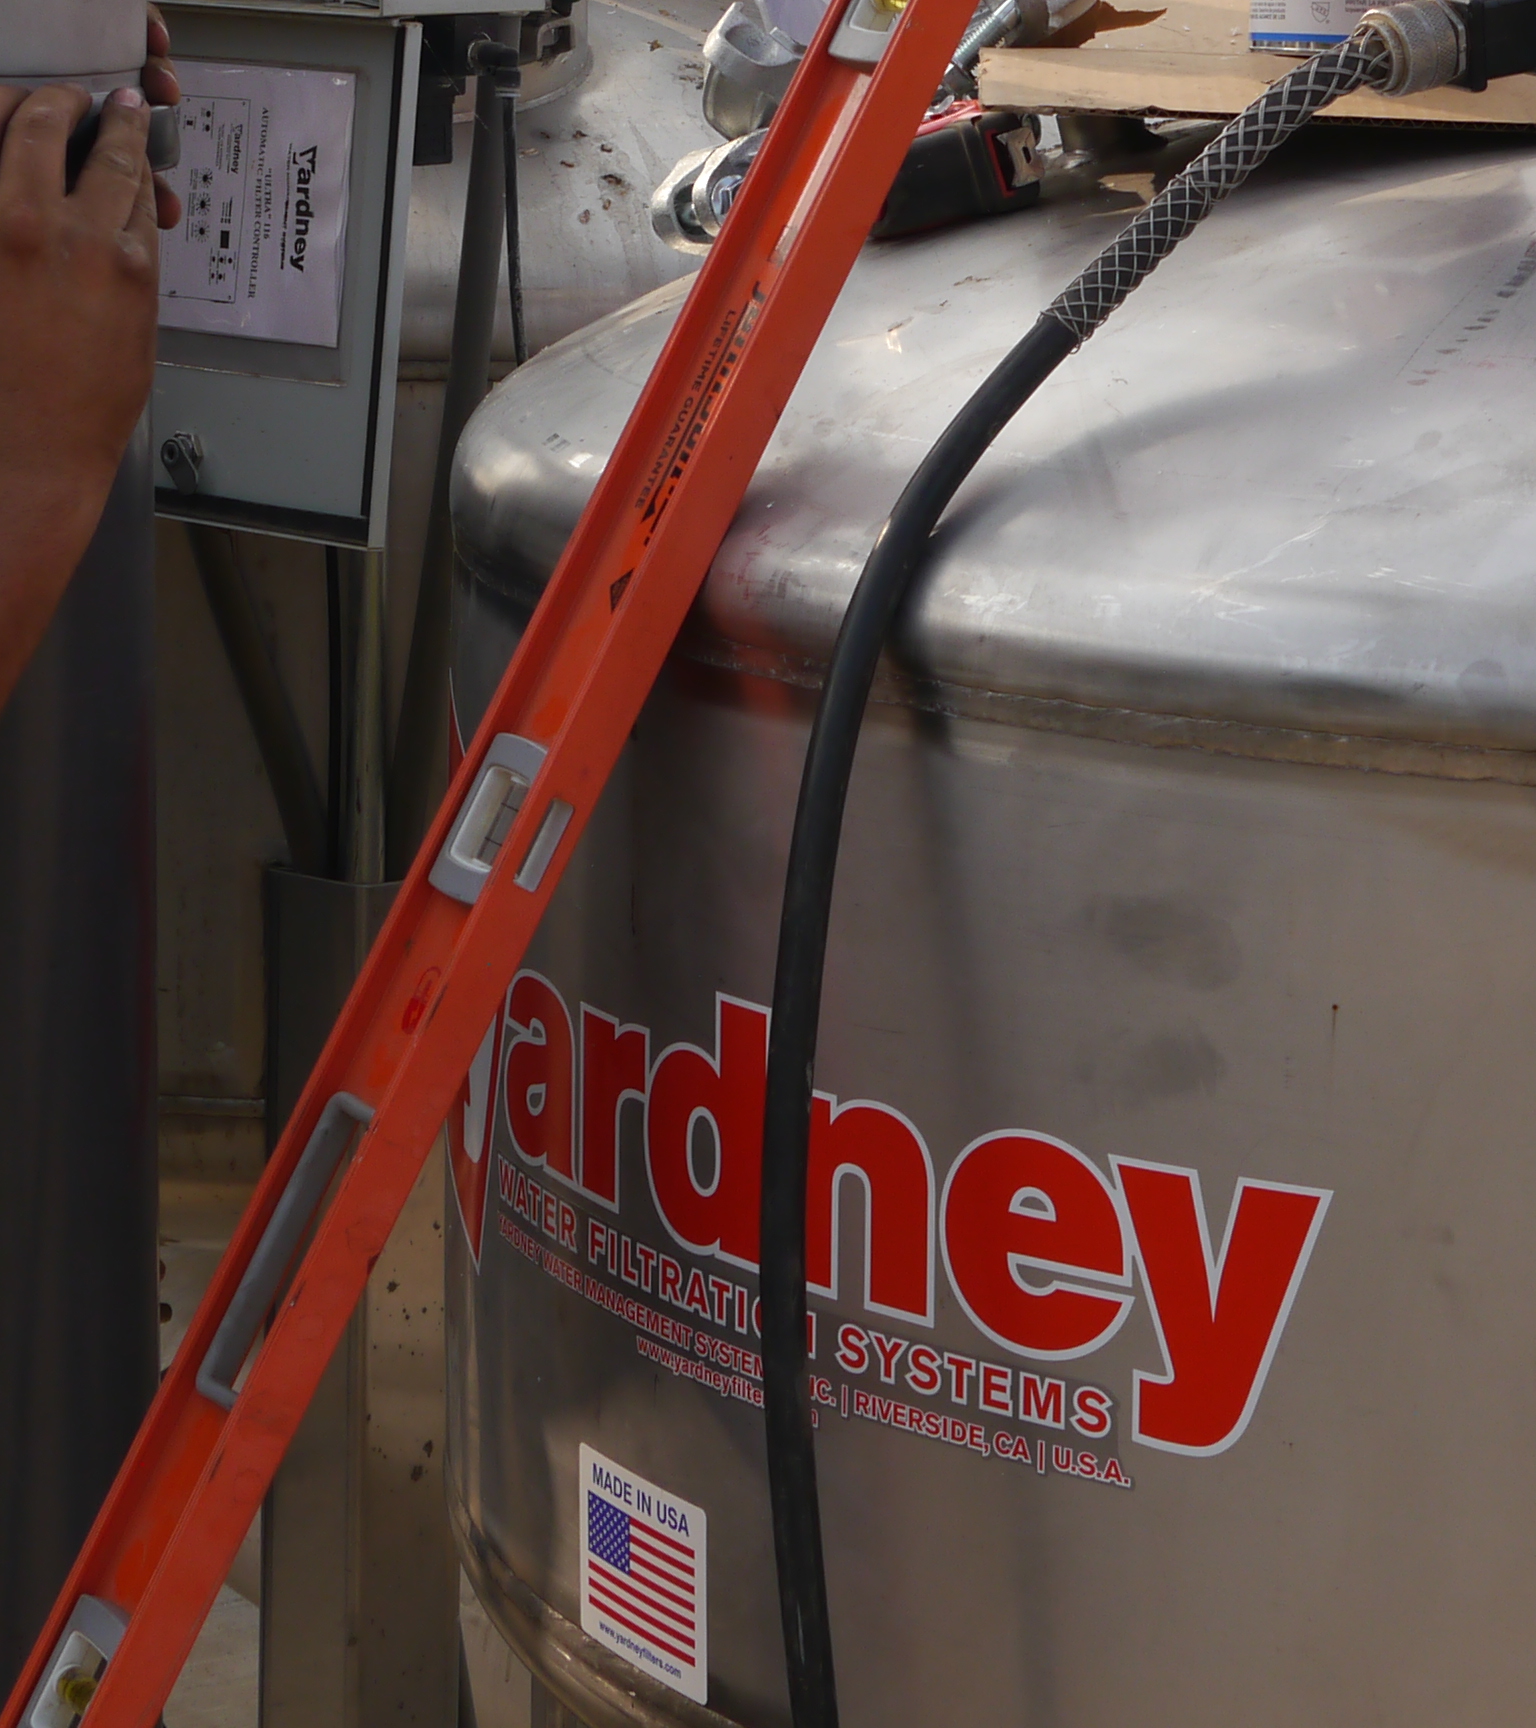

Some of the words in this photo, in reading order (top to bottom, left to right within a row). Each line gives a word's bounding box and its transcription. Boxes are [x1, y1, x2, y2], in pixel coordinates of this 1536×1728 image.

[256, 107, 270, 175] AUTOMATIC
[254, 177, 263, 218] FILTER
[289, 145, 317, 273] Yardney
[247, 221, 262, 299] CONTROLLER
[691, 309, 737, 392] LIFETIME
[635, 395, 694, 510] GUARANTEE
[445, 968, 1334, 1458] ardney
[497, 1153, 578, 1254] WATER
[588, 1218, 817, 1360] FILTRATI
[834, 1322, 1114, 1438] SYSTEMS
[542, 1249, 583, 1295] WATER
[584, 1275, 693, 1351] MANAGEMENT
[853, 1388, 991, 1456] RIVERSIDE,
[993, 1431, 1032, 1464] CA
[1052, 1444, 1132, 1488] U.S.A.
[592, 1463, 632, 1505] MADE
[637, 1489, 652, 1517] IN
[657, 1503, 690, 1537] USA
[599, 1620, 682, 1680] www.yardneyfilters.com
